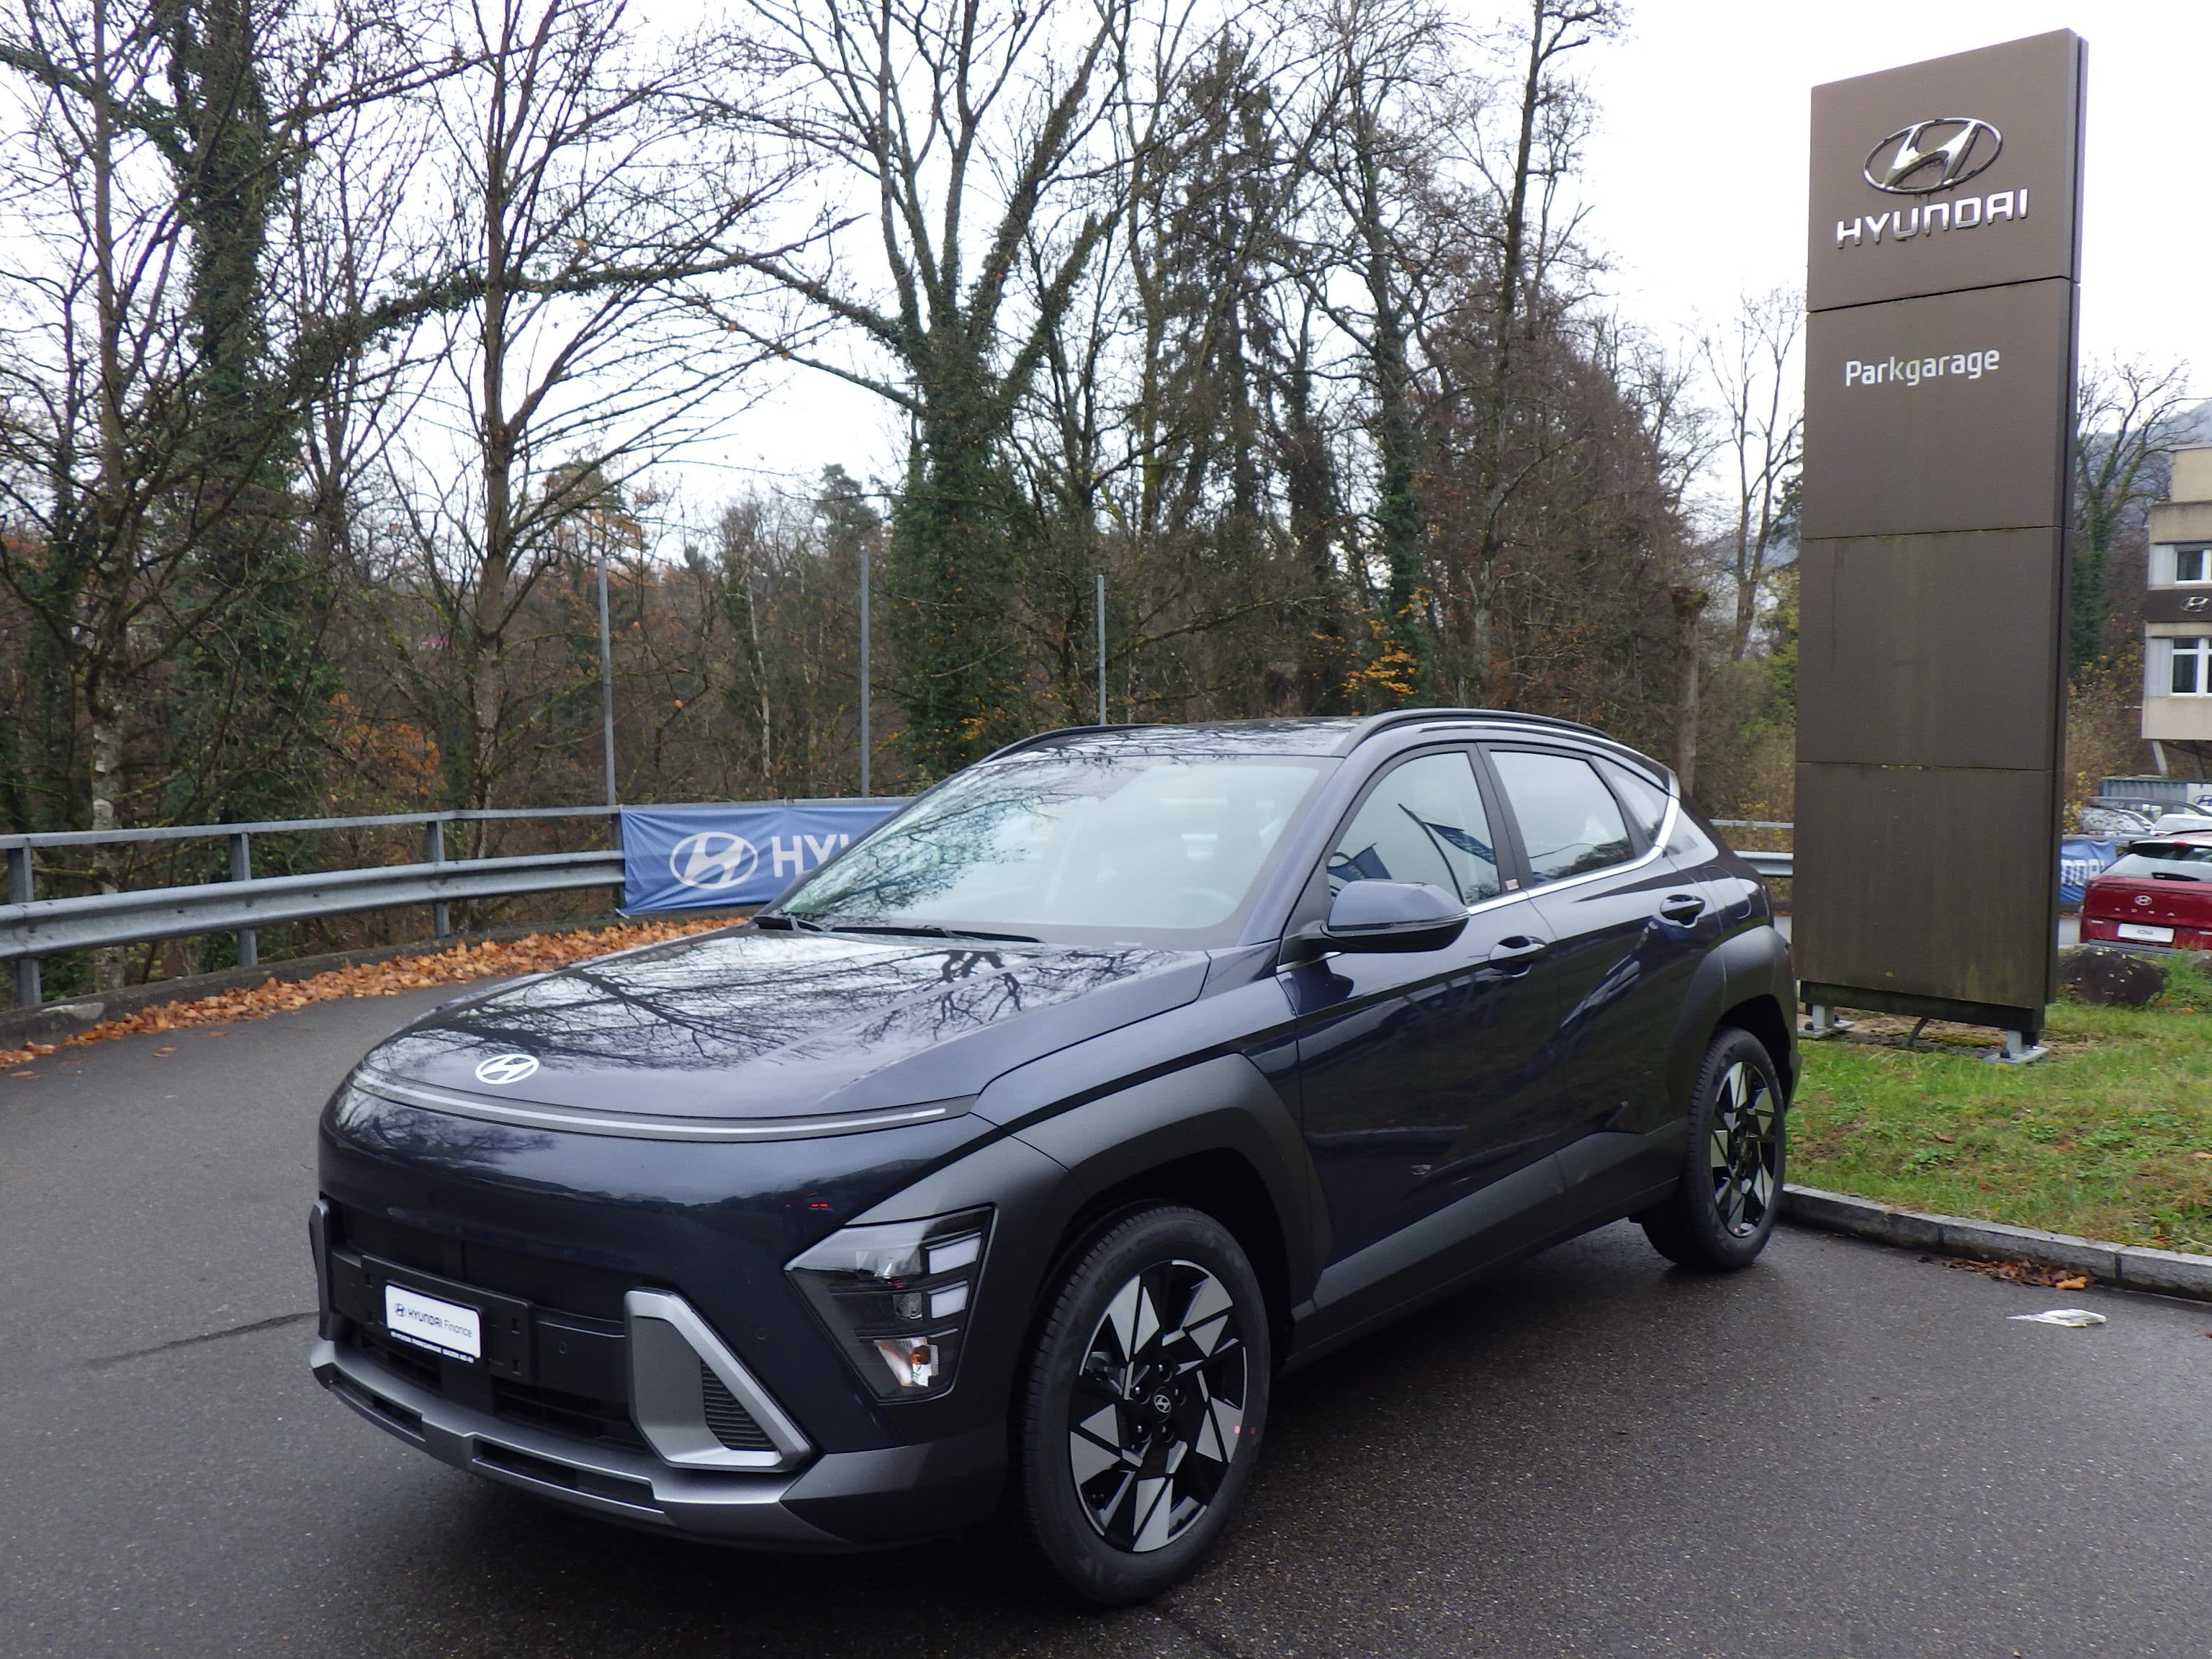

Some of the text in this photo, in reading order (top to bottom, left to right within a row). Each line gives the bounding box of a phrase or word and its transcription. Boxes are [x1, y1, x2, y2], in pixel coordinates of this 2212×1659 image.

[1835, 188, 2030, 250] HYUNDAI
[1844, 347, 2000, 387] Parkgarage
[771, 833, 849, 878] HY
[408, 1308, 472, 1337] HYUNDAI Finance
